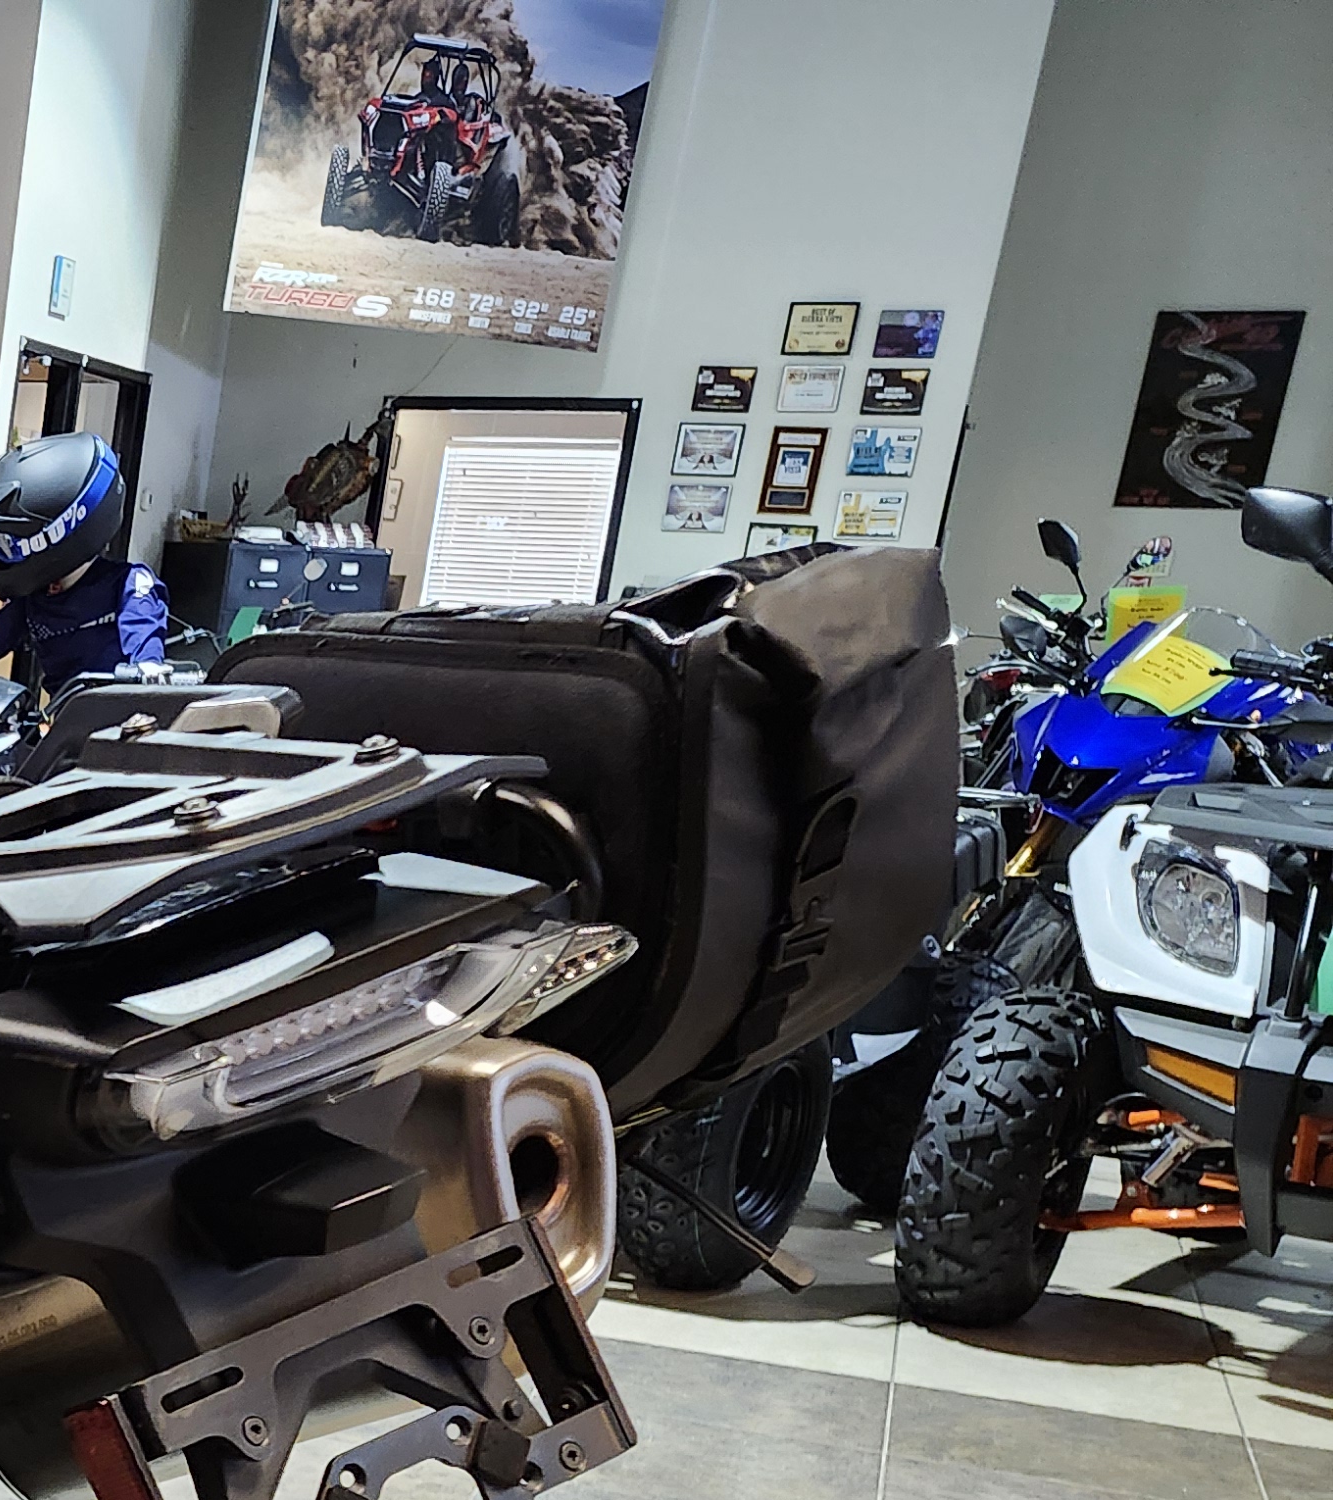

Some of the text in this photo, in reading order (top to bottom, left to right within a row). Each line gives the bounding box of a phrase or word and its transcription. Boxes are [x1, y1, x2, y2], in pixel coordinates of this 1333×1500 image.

[245, 283, 393, 318] TURBO S
[412, 286, 455, 309] 168
[17, 500, 87, 556] 100%
